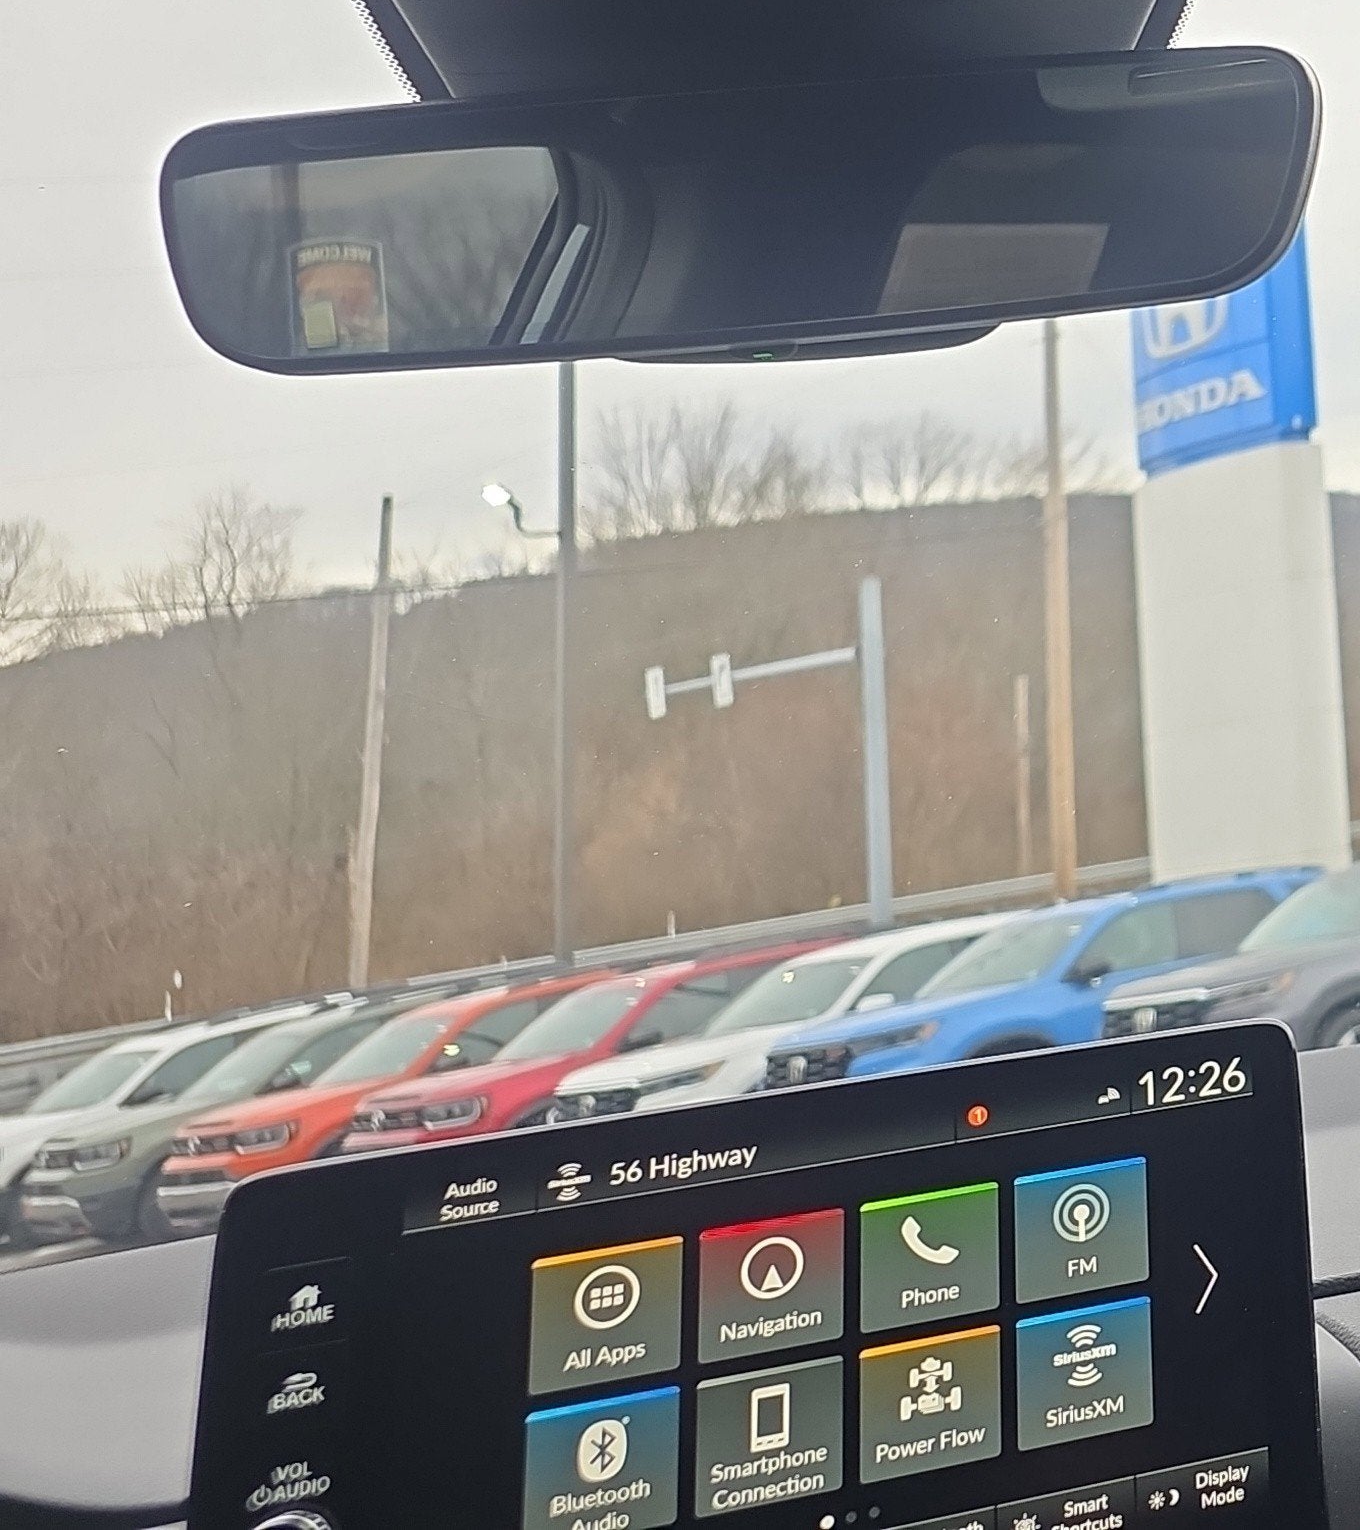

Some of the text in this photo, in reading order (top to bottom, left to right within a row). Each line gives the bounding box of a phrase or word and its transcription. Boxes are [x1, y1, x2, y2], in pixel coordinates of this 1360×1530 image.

[1138, 1057, 1247, 1106] 12:26
[609, 1159, 643, 1186] 56
[650, 1145, 758, 1180] Highway
[444, 1177, 498, 1201] Audio
[439, 1199, 500, 1221] Source
[1067, 1255, 1098, 1279] FM
[901, 1282, 960, 1309] Phone
[270, 1304, 335, 1332] HOME
[719, 1310, 822, 1343] Navigation
[563, 1342, 647, 1372] All Apps
[267, 1385, 326, 1414] BACK
[1046, 1396, 1125, 1428] SiriusXM
[875, 1425, 987, 1464] Power Flow
[271, 1460, 313, 1485] VOL
[710, 1445, 828, 1484] Smartphone
[1195, 1464, 1250, 1490] Display
[269, 1475, 331, 1505] AUDIO
[550, 1478, 651, 1518] Bluetooth
[711, 1472, 825, 1510] Connection
[1201, 1488, 1245, 1509] Mode
[1064, 1493, 1109, 1519] Smart
